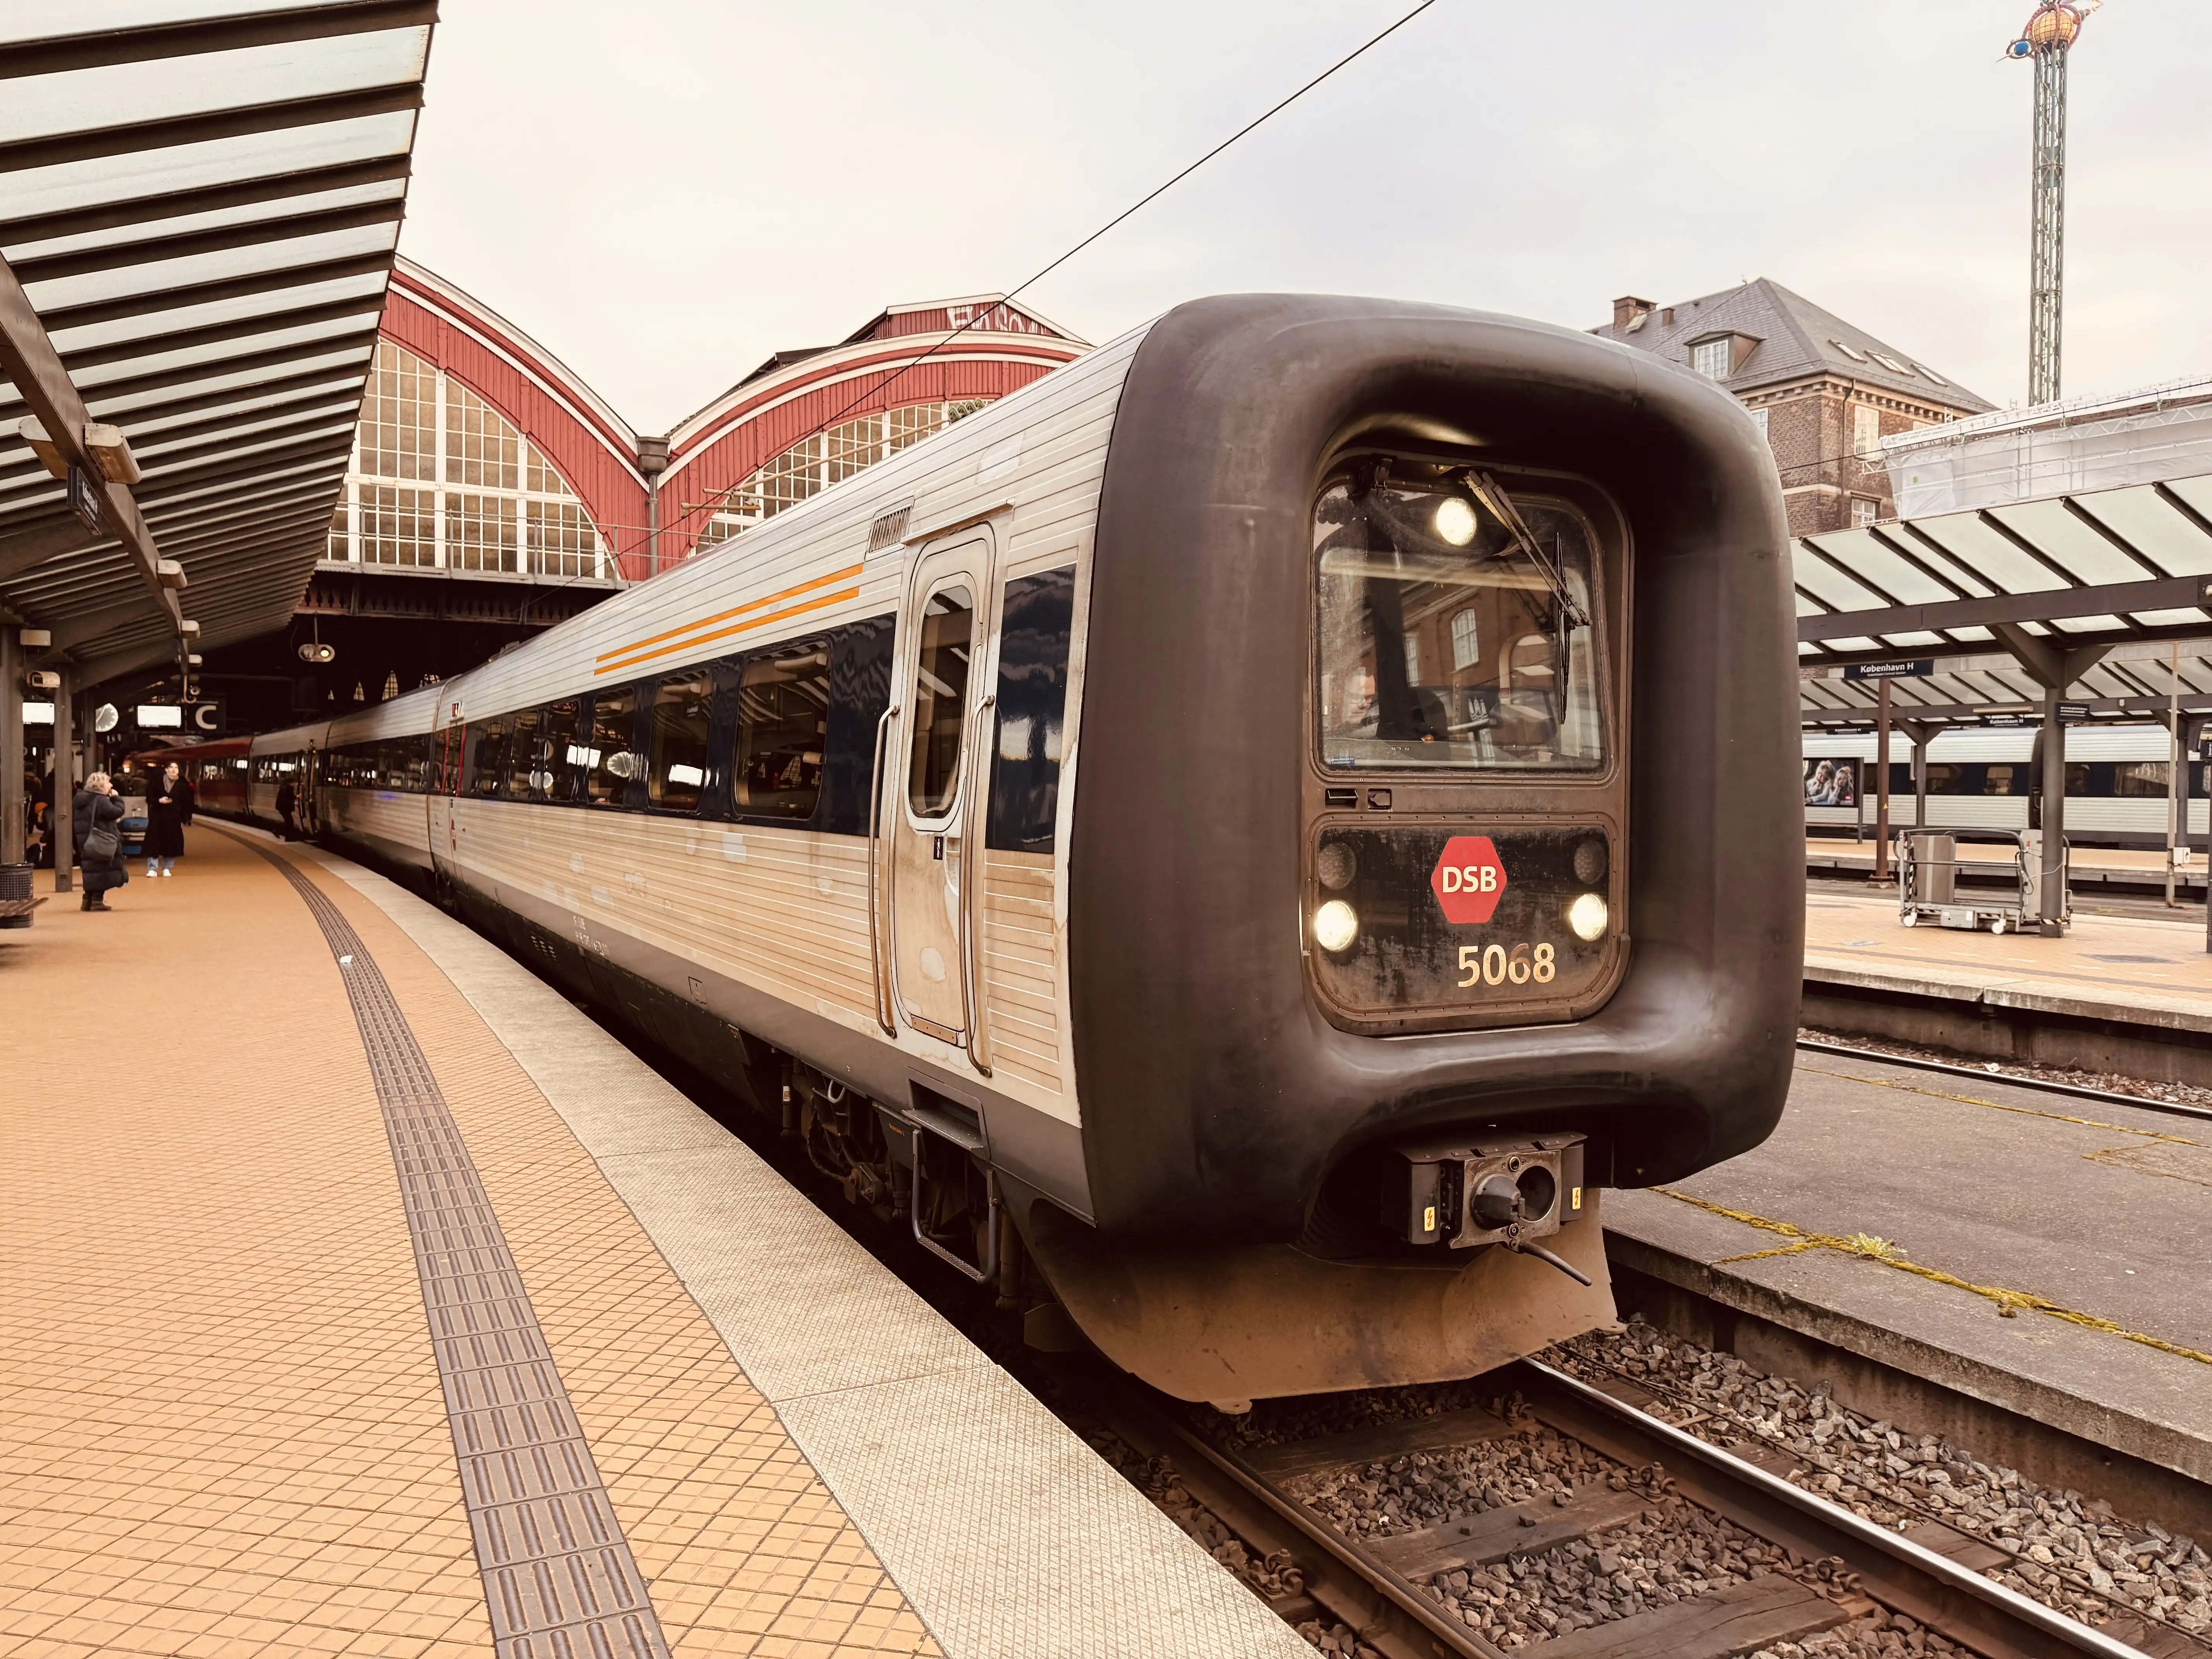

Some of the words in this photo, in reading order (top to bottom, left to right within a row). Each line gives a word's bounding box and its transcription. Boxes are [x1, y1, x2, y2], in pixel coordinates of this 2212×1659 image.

[1860, 664, 1905, 673] København
[196, 705, 216, 730] C
[1443, 866, 1497, 893] DSB
[1458, 943, 1555, 987] 5068
